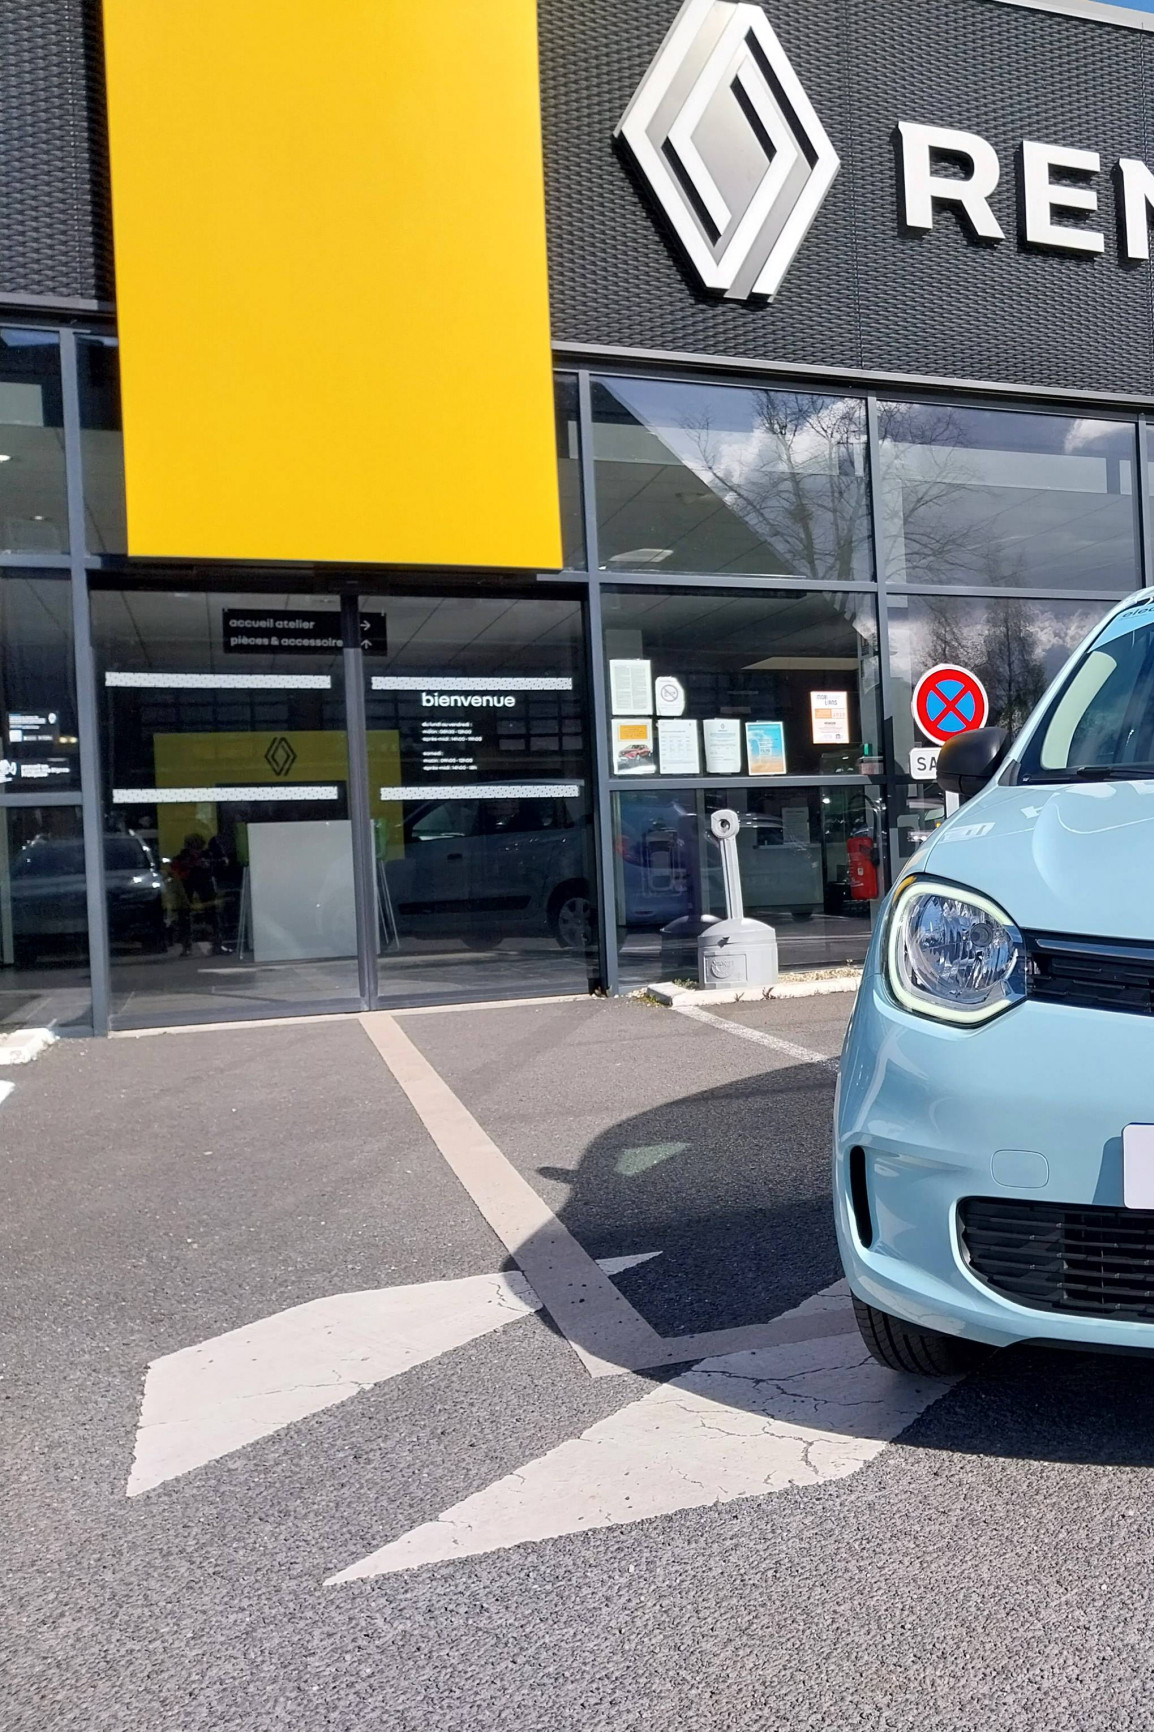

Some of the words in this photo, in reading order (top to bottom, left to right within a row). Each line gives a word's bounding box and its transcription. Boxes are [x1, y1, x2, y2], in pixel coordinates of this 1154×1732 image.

[229, 618, 273, 628] accueil
[275, 619, 315, 629] atelier
[230, 635, 269, 646] pièces
[281, 637, 343, 648] accessoire
[421, 691, 516, 707] bienvenue
[917, 757, 938, 772] SA
